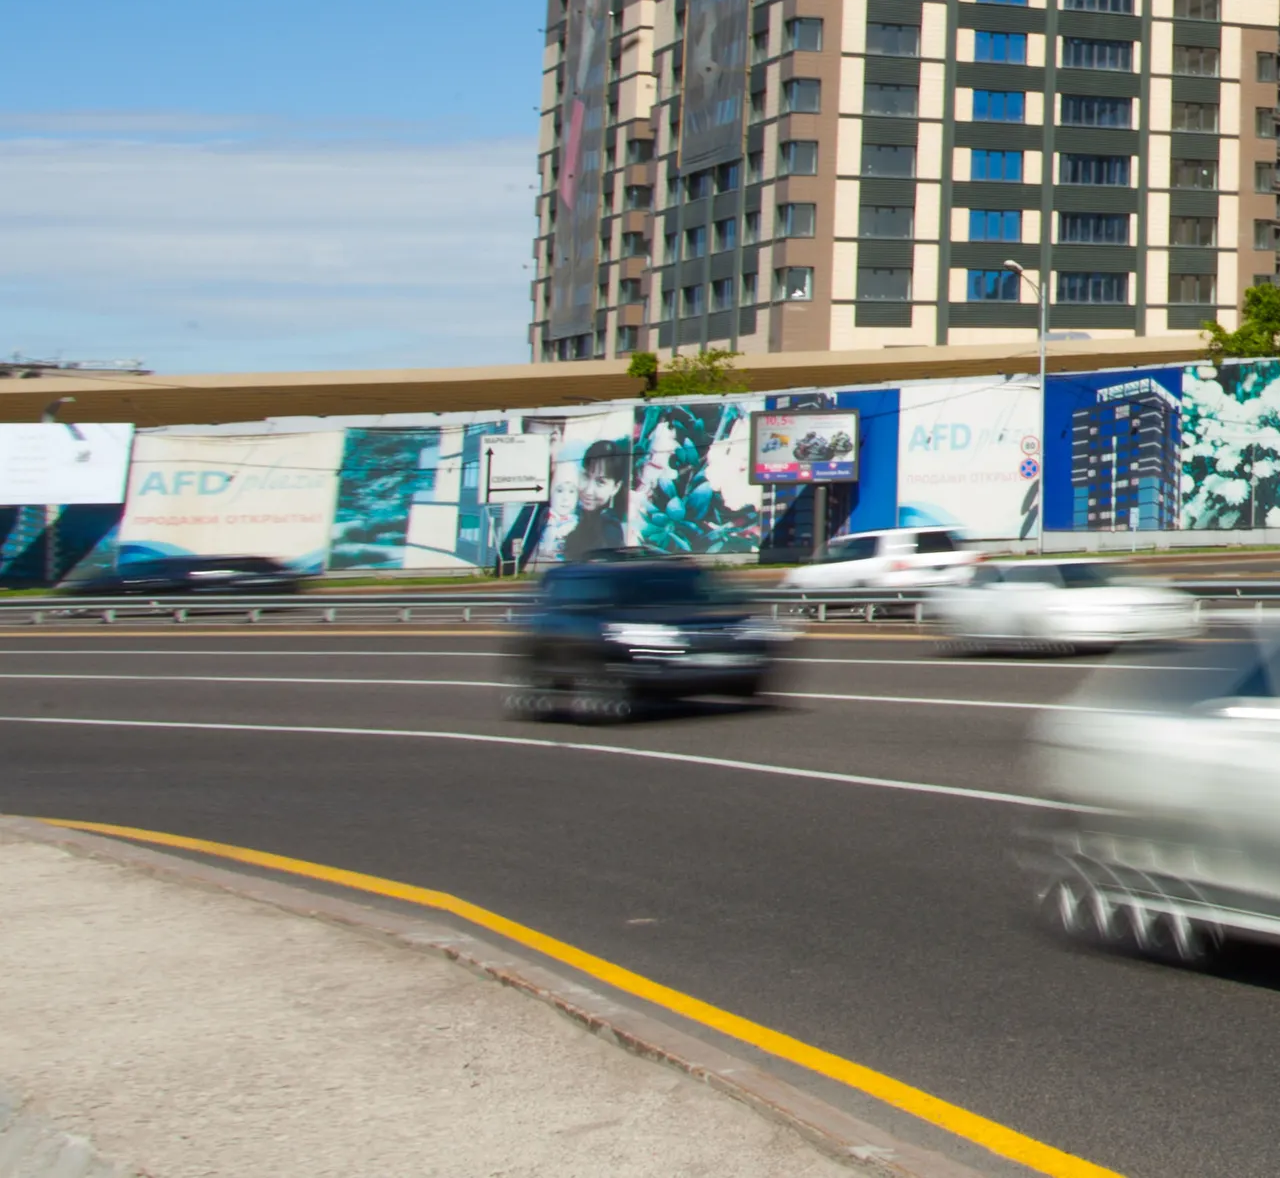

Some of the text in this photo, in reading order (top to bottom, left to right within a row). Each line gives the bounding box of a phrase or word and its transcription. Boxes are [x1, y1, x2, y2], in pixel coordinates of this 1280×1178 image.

[908, 423, 972, 452] AFD
[138, 471, 233, 496] AFD
[907, 474, 965, 484] ПРОДАЖИ
[133, 515, 219, 526] ПРОДАЖИ
